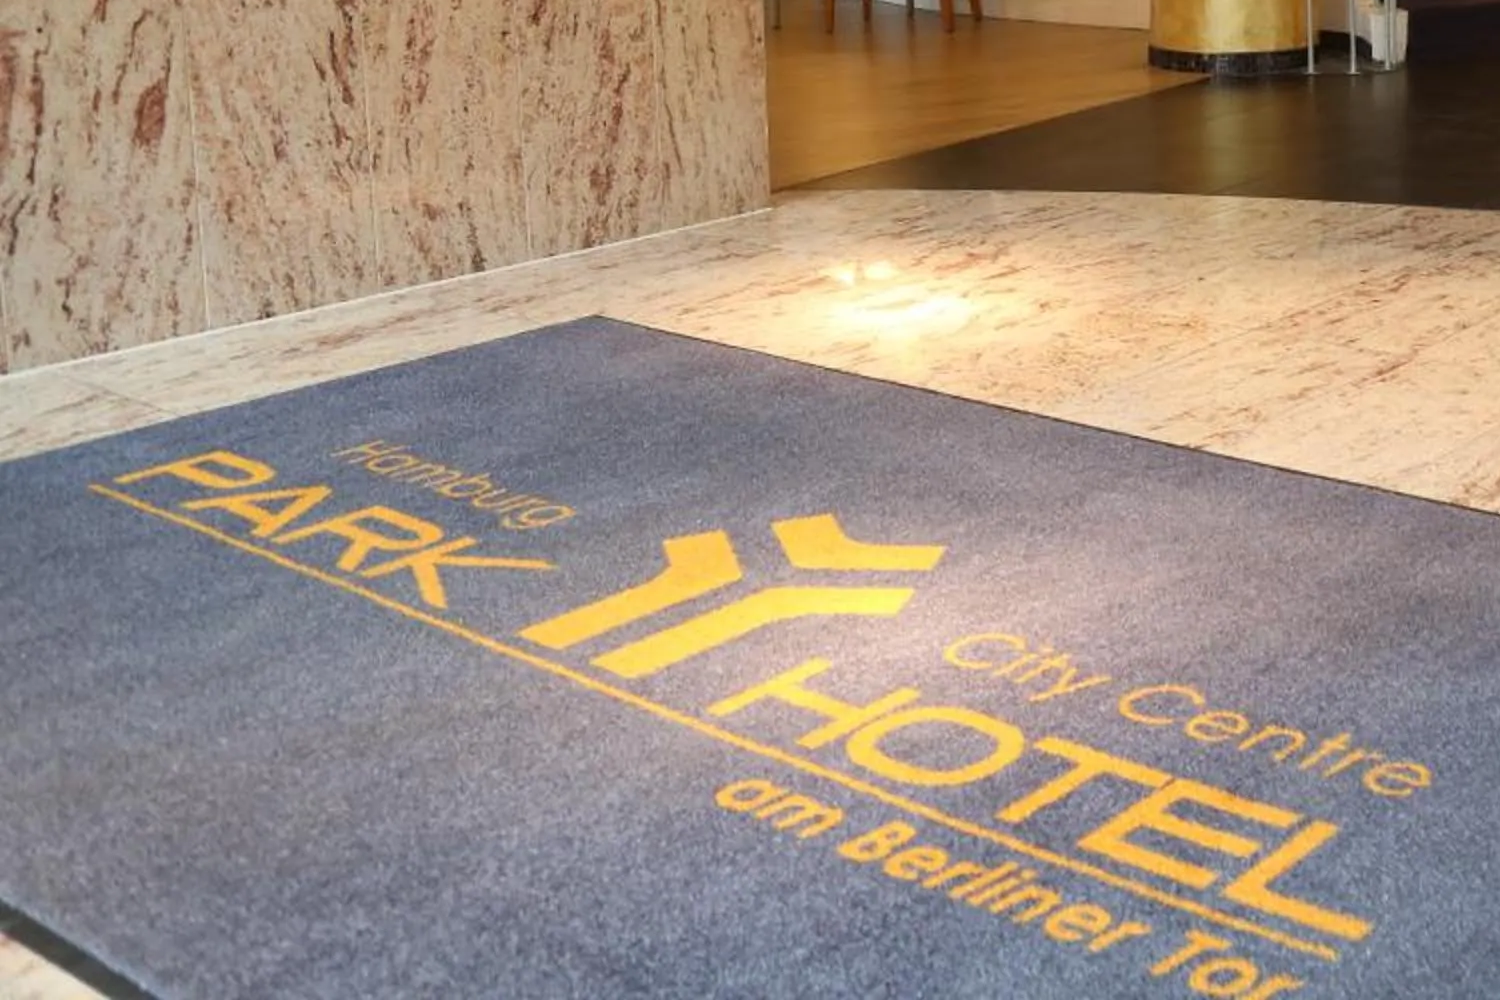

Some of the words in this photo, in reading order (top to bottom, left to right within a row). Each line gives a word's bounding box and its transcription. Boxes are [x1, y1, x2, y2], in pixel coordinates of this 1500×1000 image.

[114, 450, 558, 608] PARK
[706, 657, 1375, 942] HOTEL
[329, 439, 577, 530] Hamburg
[943, 632, 1110, 703] City
[1117, 682, 1434, 799] Centre
[715, 777, 844, 838] am
[836, 819, 1151, 954] Berliner
[1149, 929, 1306, 1000] Tor
